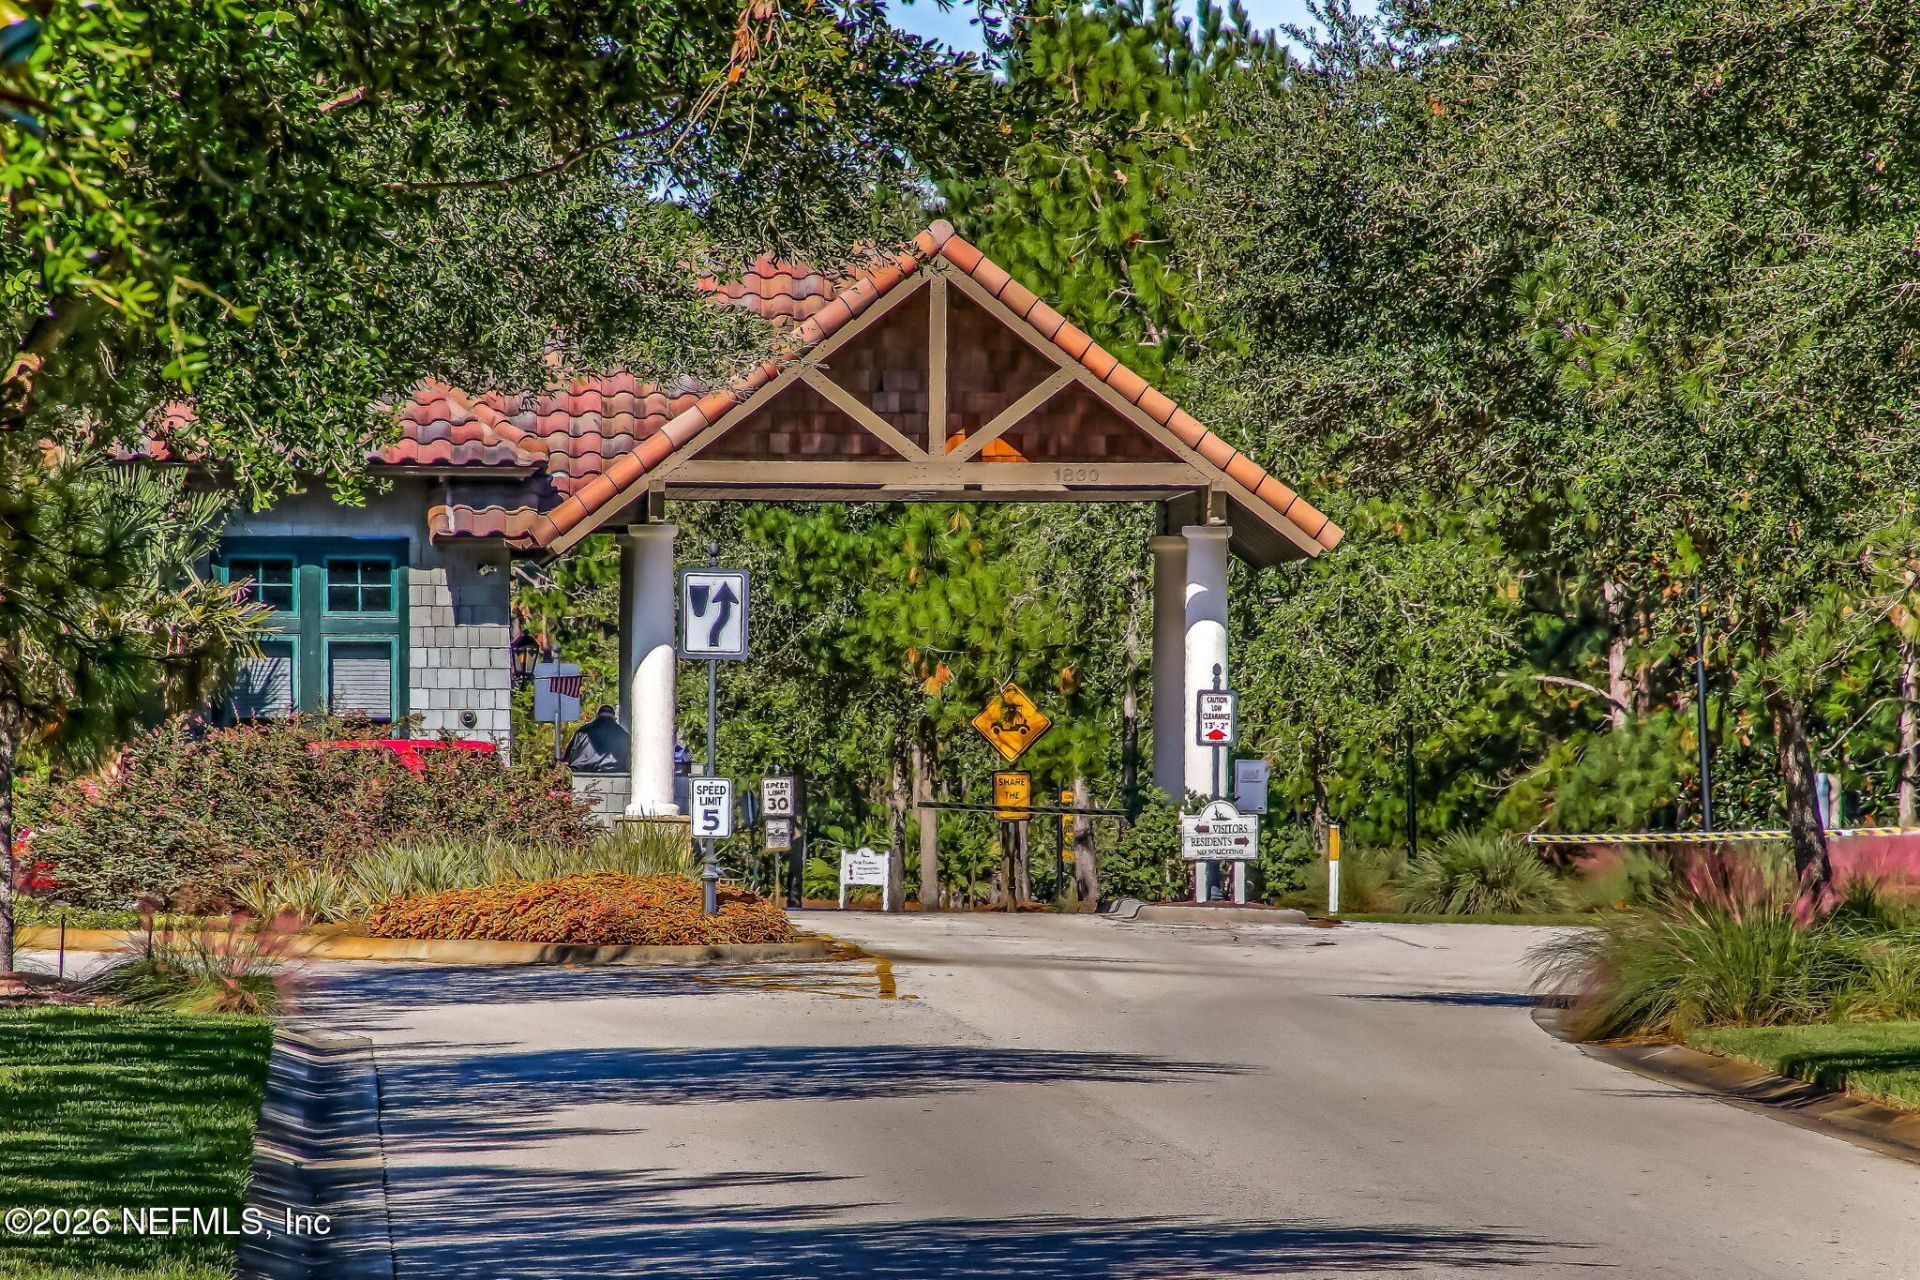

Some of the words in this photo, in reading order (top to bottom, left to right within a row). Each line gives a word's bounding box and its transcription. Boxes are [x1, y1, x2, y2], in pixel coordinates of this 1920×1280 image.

[1206, 696, 1228, 704] CAUTION
[1211, 704, 1222, 712] LOW
[998, 777, 1025, 786] SHARE
[696, 785, 727, 795] SPEED
[1005, 791, 1020, 800] THE
[699, 796, 723, 806] LIMIT
[767, 797, 789, 811] 30
[702, 808, 720, 831] 5
[1212, 824, 1248, 834] VISITORS
[1190, 837, 1233, 847] RESIDENTS
